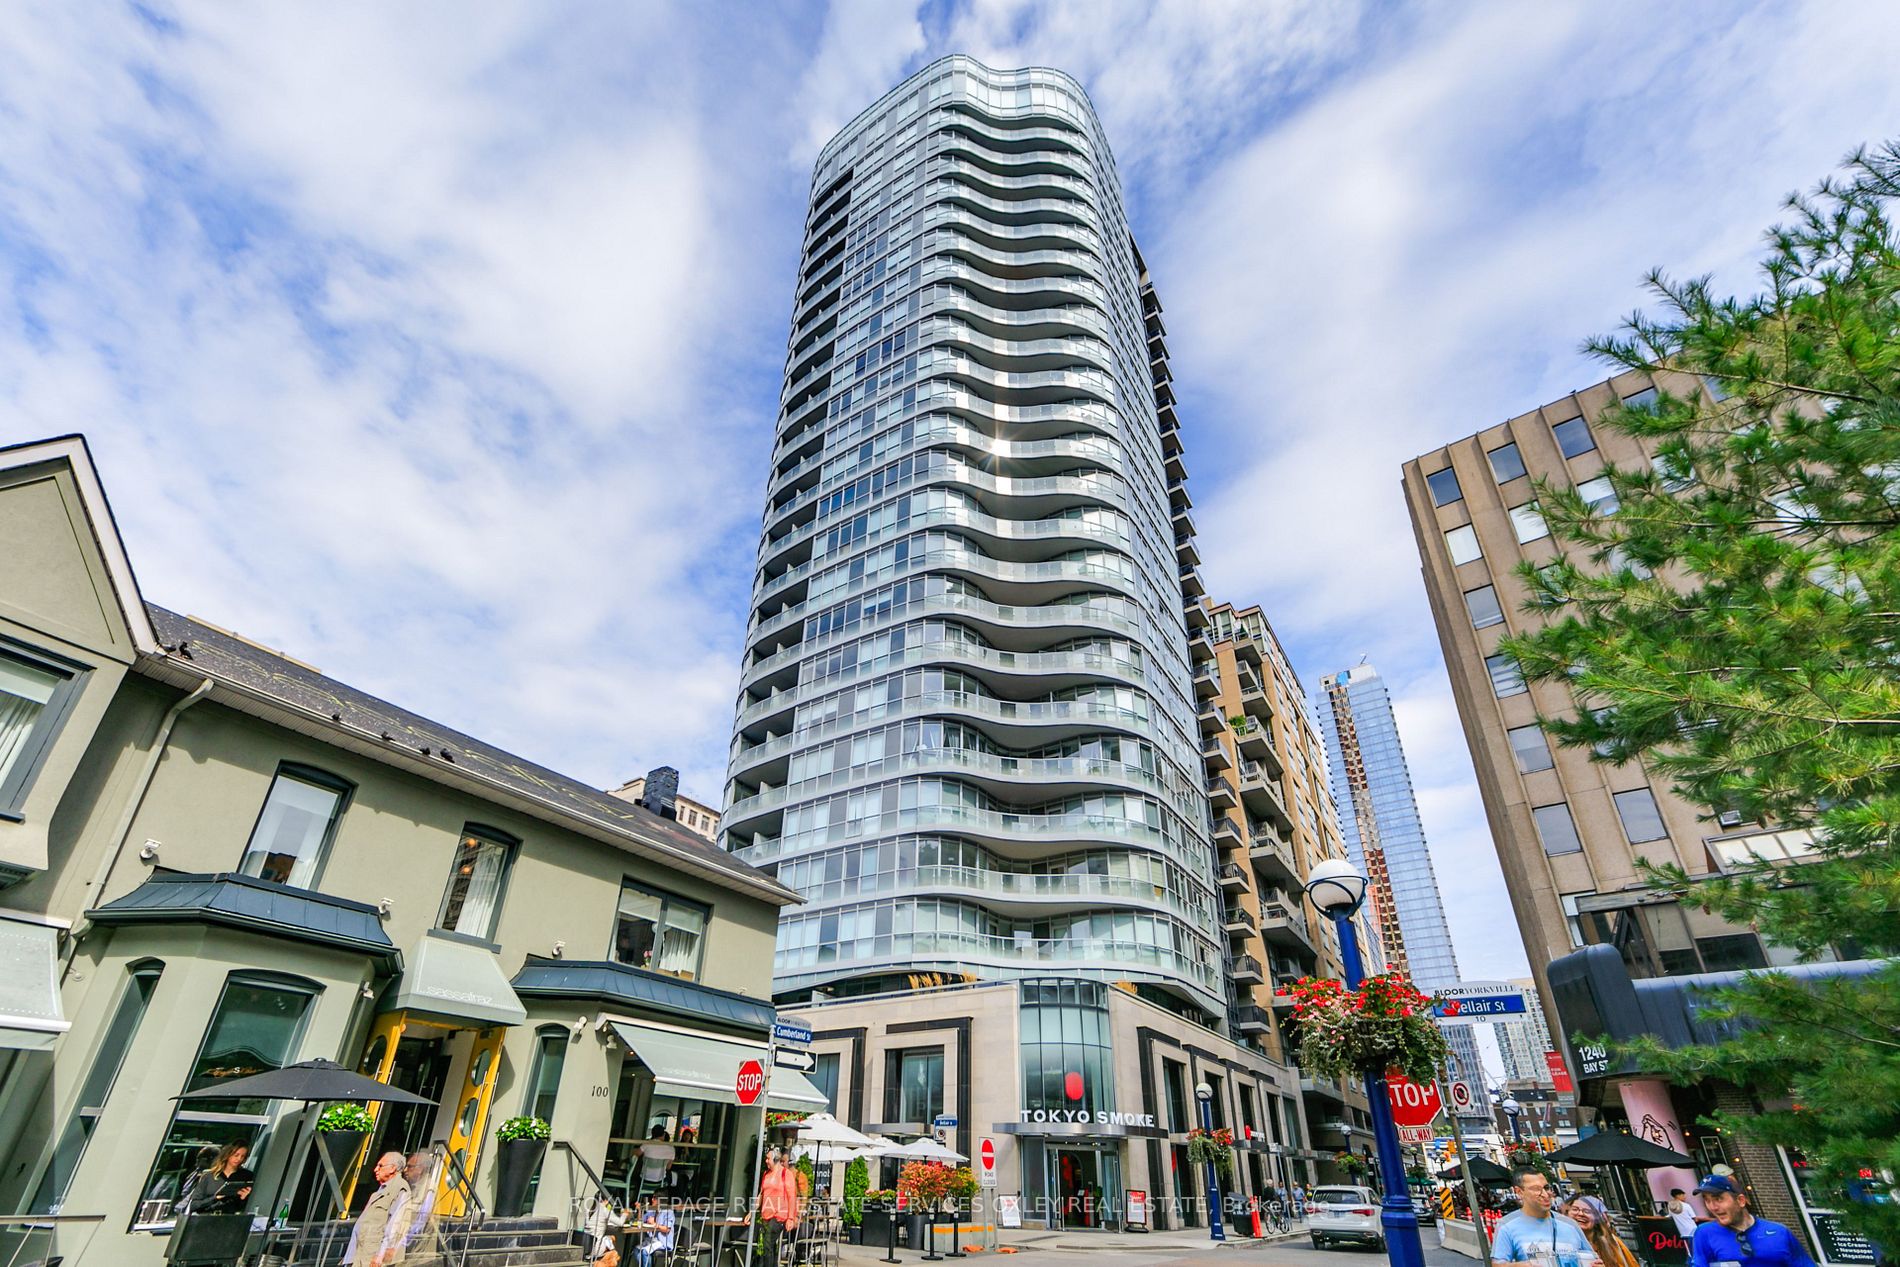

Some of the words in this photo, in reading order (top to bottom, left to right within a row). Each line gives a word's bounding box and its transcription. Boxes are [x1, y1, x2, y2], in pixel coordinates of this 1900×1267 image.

[1457, 999, 1491, 1014] ellair
[1495, 1001, 1506, 1012] St
[1583, 1062, 1599, 1074] BAY
[1599, 1060, 1609, 1071] ST
[737, 1073, 763, 1092] STOP
[591, 1085, 609, 1098] 100
[1389, 1082, 1435, 1107] TOP
[1020, 1109, 1090, 1124] TOKYO
[1097, 1111, 1155, 1127] SMOKE
[1401, 1129, 1432, 1142] ALL-WAY
